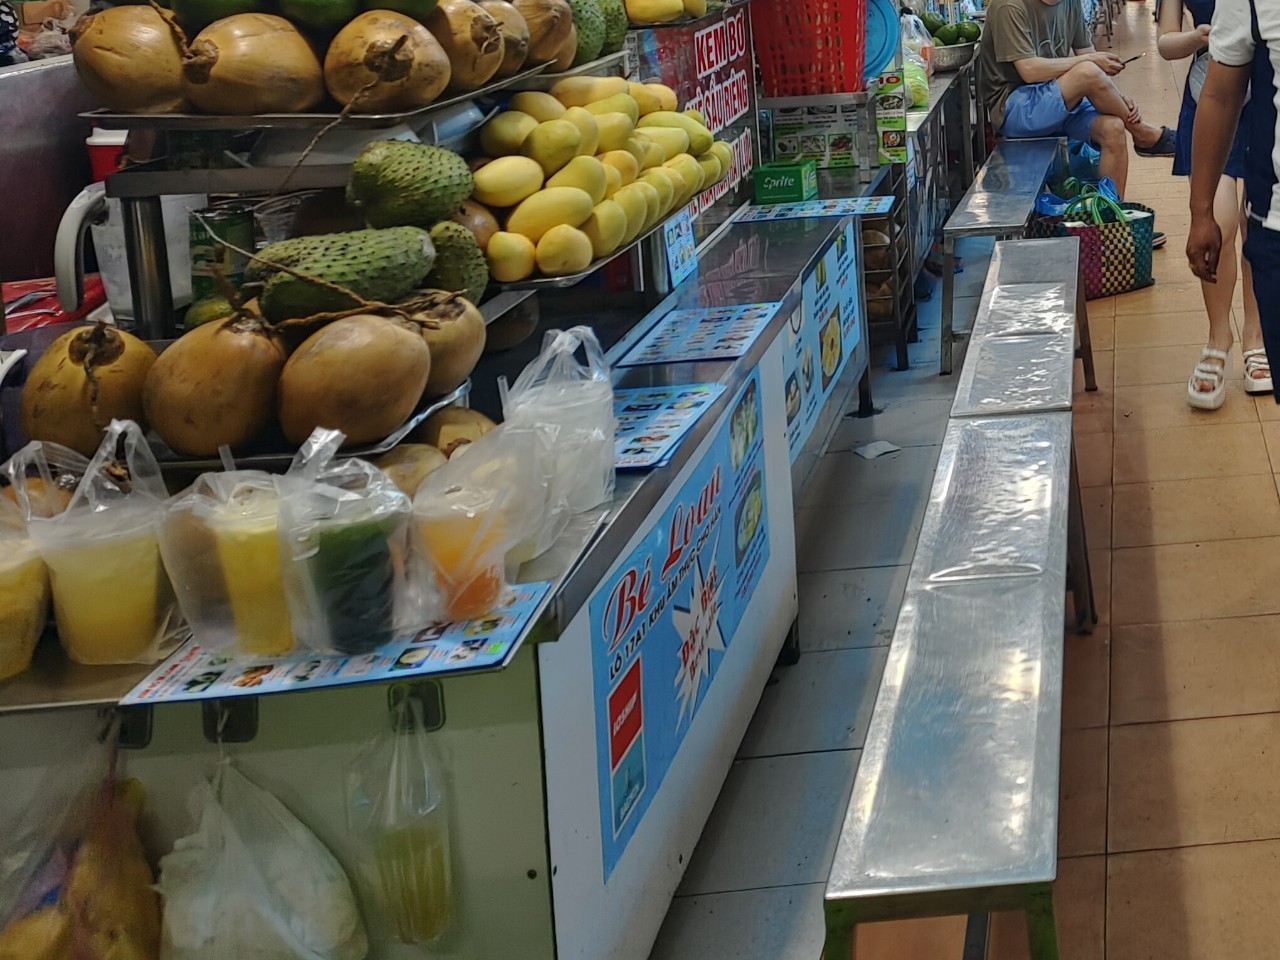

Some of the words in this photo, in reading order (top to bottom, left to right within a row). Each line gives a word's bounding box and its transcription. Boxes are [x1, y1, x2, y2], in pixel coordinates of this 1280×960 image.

[696, 24, 727, 77] KEM
[727, 10, 745, 59] BƠ
[704, 74, 724, 134] SẦU
[724, 70, 748, 126] RIÊNG
[763, 175, 795, 189] Sprite
[603, 555, 652, 653] Bé
[660, 464, 721, 582] Loan
[609, 652, 622, 681] LÔ
[625, 625, 647, 659] 17A1
[648, 597, 666, 628] KHU
[666, 575, 679, 605] ẨM
